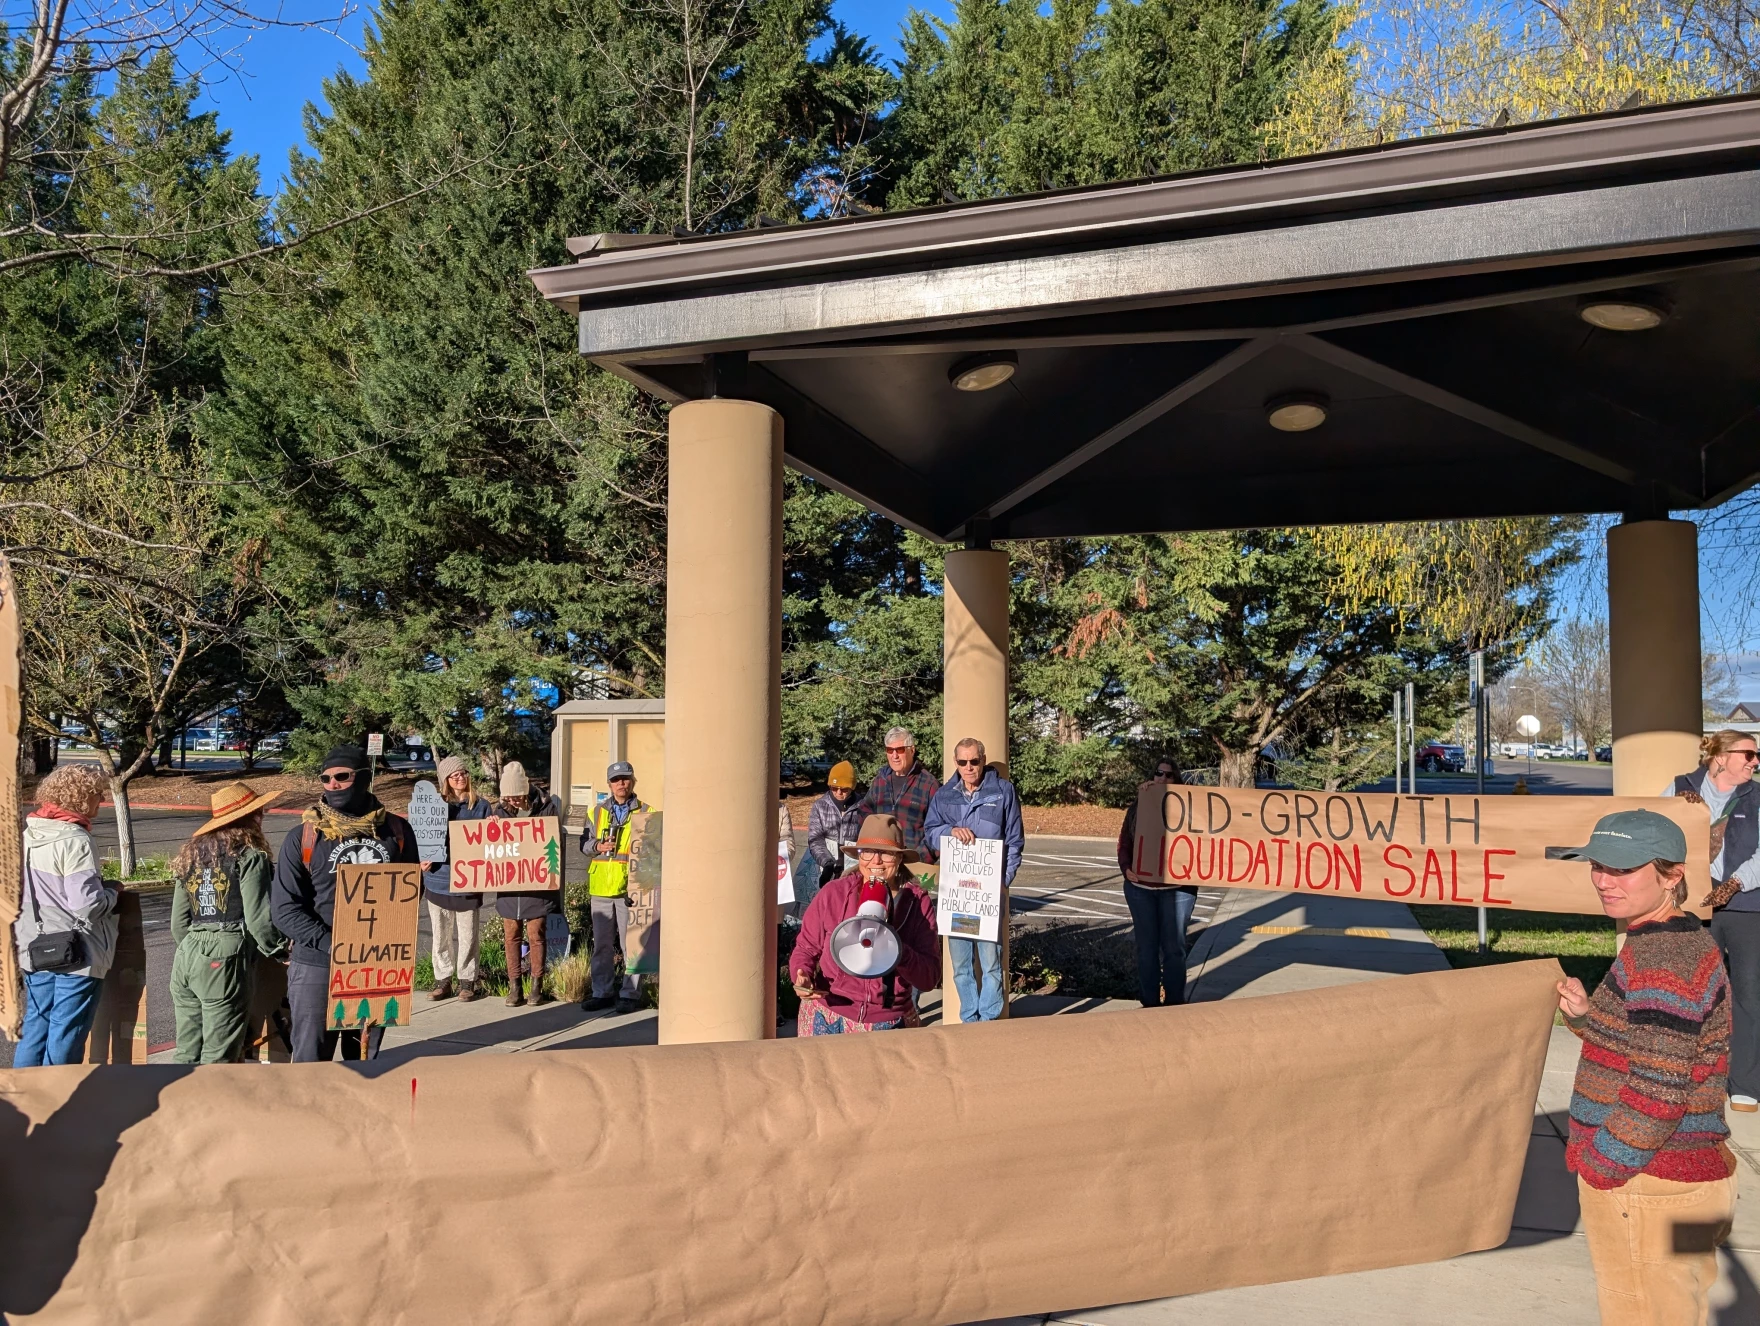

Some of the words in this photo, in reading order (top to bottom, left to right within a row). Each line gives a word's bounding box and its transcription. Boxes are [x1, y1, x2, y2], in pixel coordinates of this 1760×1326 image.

[416, 795, 432, 804] HERE
[411, 806, 426, 815] LIES
[430, 806, 446, 816] OUR
[1161, 790, 1480, 845] OLD-GROWTH
[462, 818, 546, 846] WORTH
[361, 838, 377, 847] FOR
[375, 843, 391, 864] PEACE
[484, 842, 521, 860] MORE
[978, 839, 998, 854] THE
[952, 849, 992, 866] PUBLIC
[453, 856, 548, 889] STANDING
[948, 861, 994, 876] INVOLVED
[1136, 834, 1362, 892] LIQUIDATION
[1383, 843, 1517, 905] SALE
[340, 869, 419, 905] VETS
[948, 887, 959, 898] IN
[964, 890, 980, 902] USE
[981, 892, 993, 903] OF
[199, 906, 217, 917] LAND
[941, 897, 971, 914] PUBLIC
[974, 903, 999, 917] LANDS
[356, 908, 378, 940] 4
[332, 942, 412, 965] CLIMATE
[329, 966, 415, 991] ACTION
